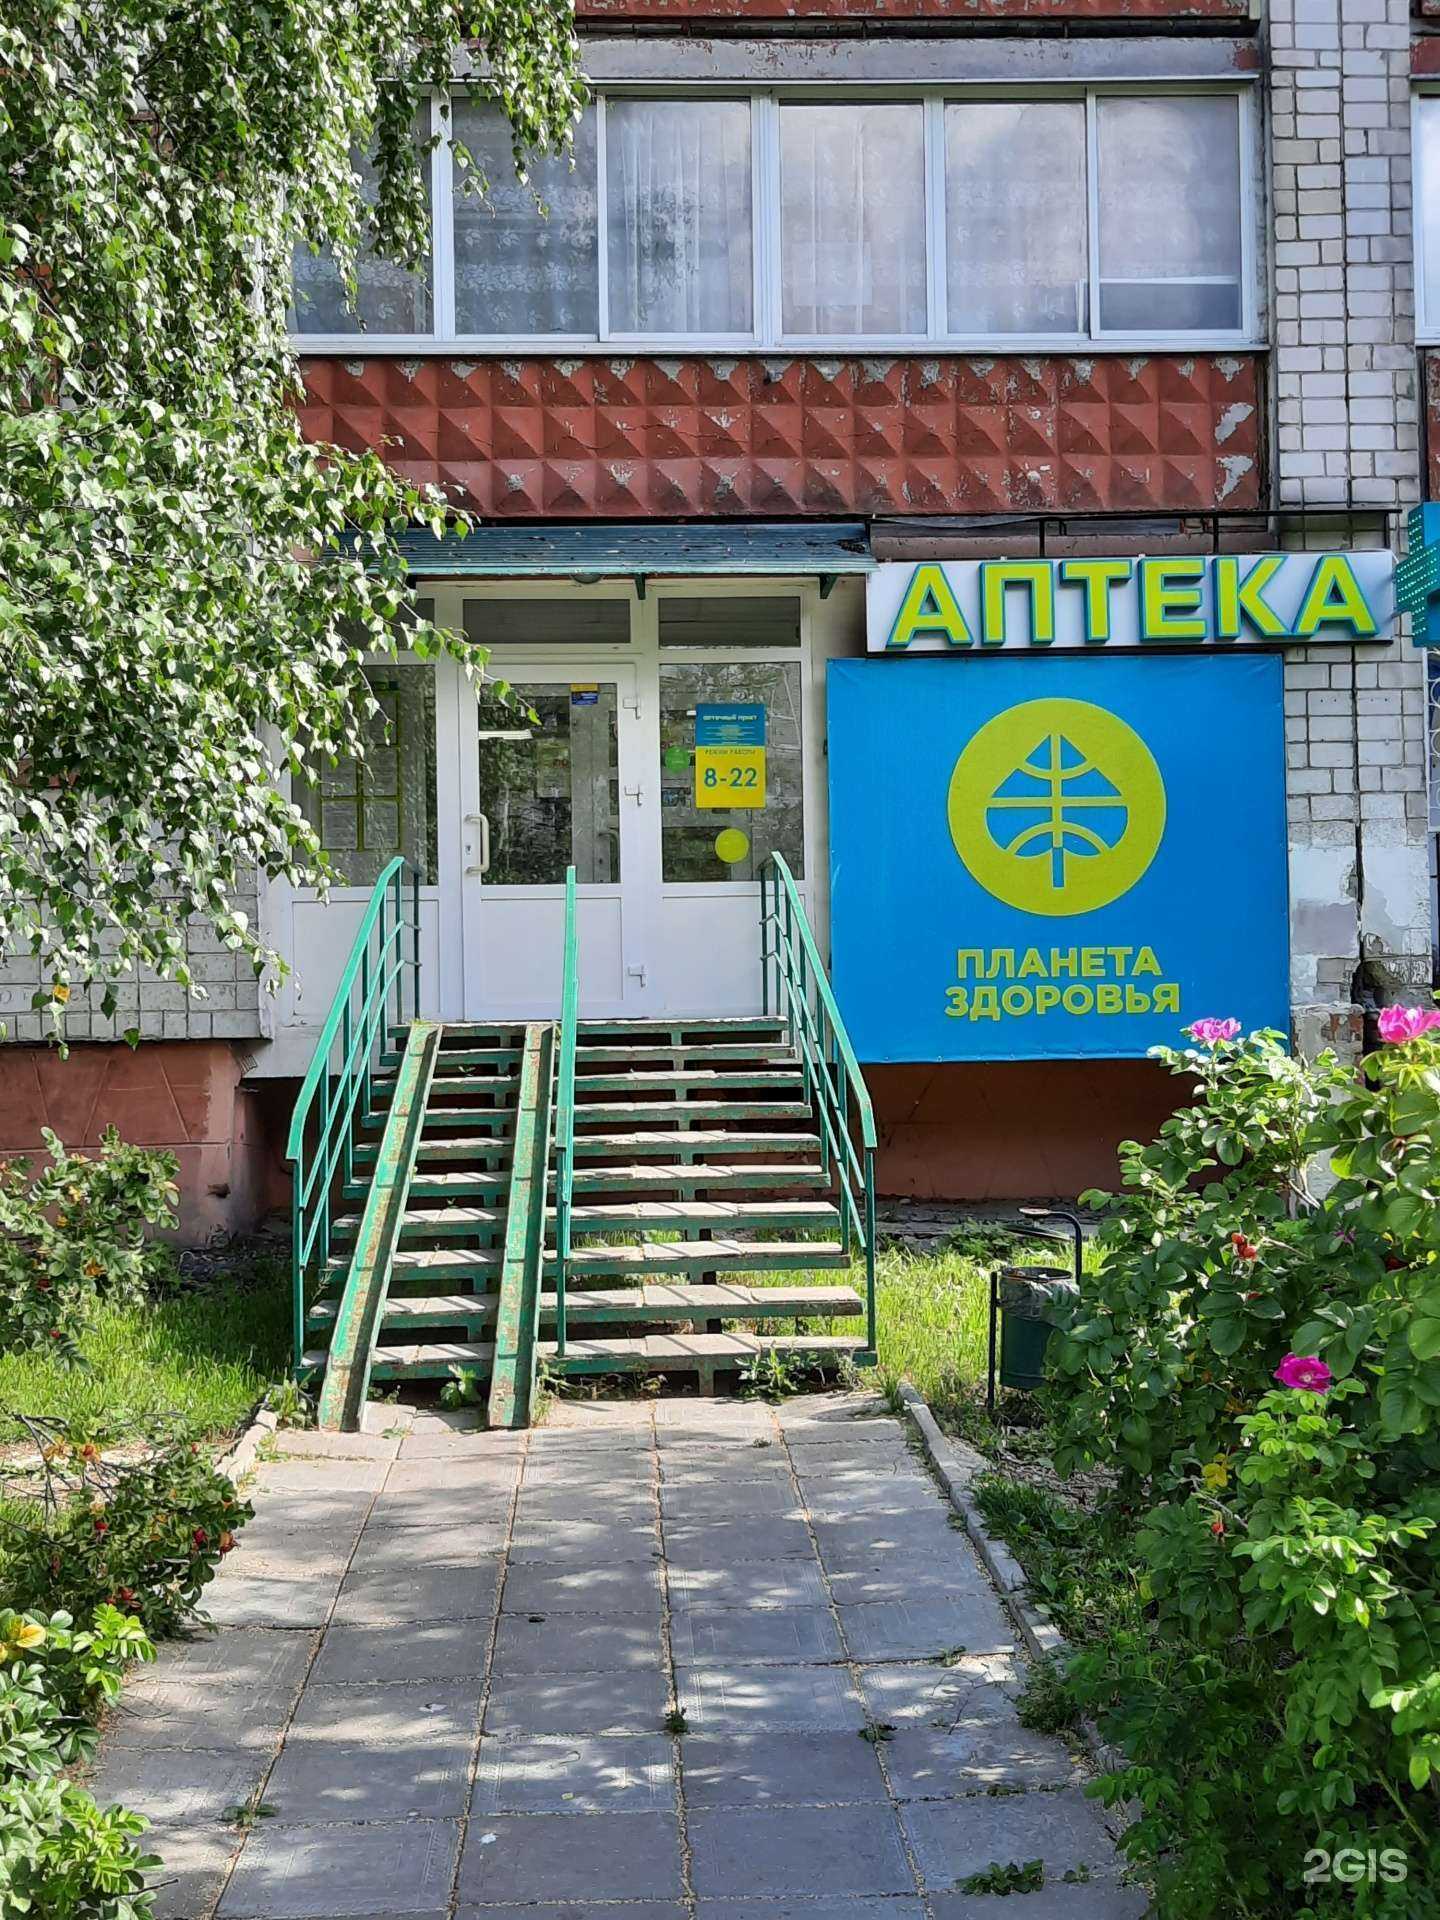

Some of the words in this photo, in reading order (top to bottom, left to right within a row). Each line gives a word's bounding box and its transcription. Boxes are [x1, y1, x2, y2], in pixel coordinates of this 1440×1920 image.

[885, 554, 1379, 648] АПТЕКА
[704, 767, 758, 788] 8-22
[957, 945, 1163, 979] ПЛАНЕТА
[944, 983, 1181, 1022] ЗДОРОВЬЯ
